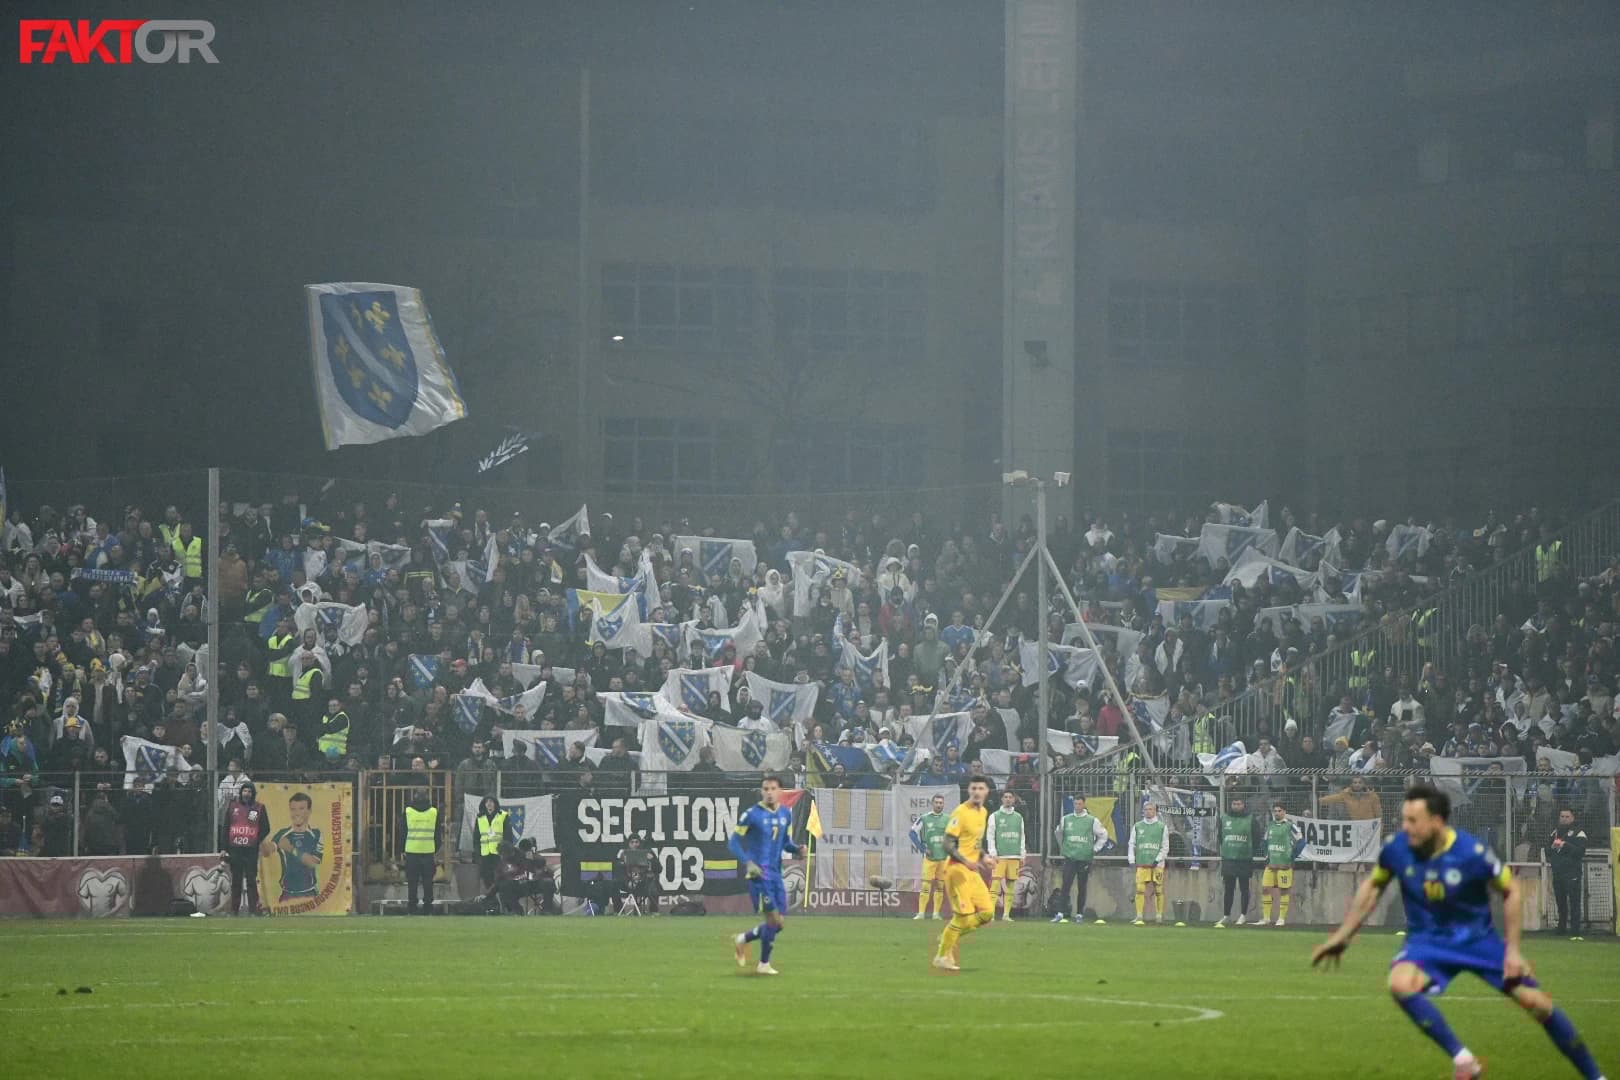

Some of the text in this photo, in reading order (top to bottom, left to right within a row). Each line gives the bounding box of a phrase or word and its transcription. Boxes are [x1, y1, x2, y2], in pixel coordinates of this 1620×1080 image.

[577, 796, 740, 843] SECTION
[233, 836, 249, 845] 420
[771, 826, 779, 840] 7
[1297, 820, 1352, 847] JAJCE
[809, 891, 901, 907] QUALIFIERS
